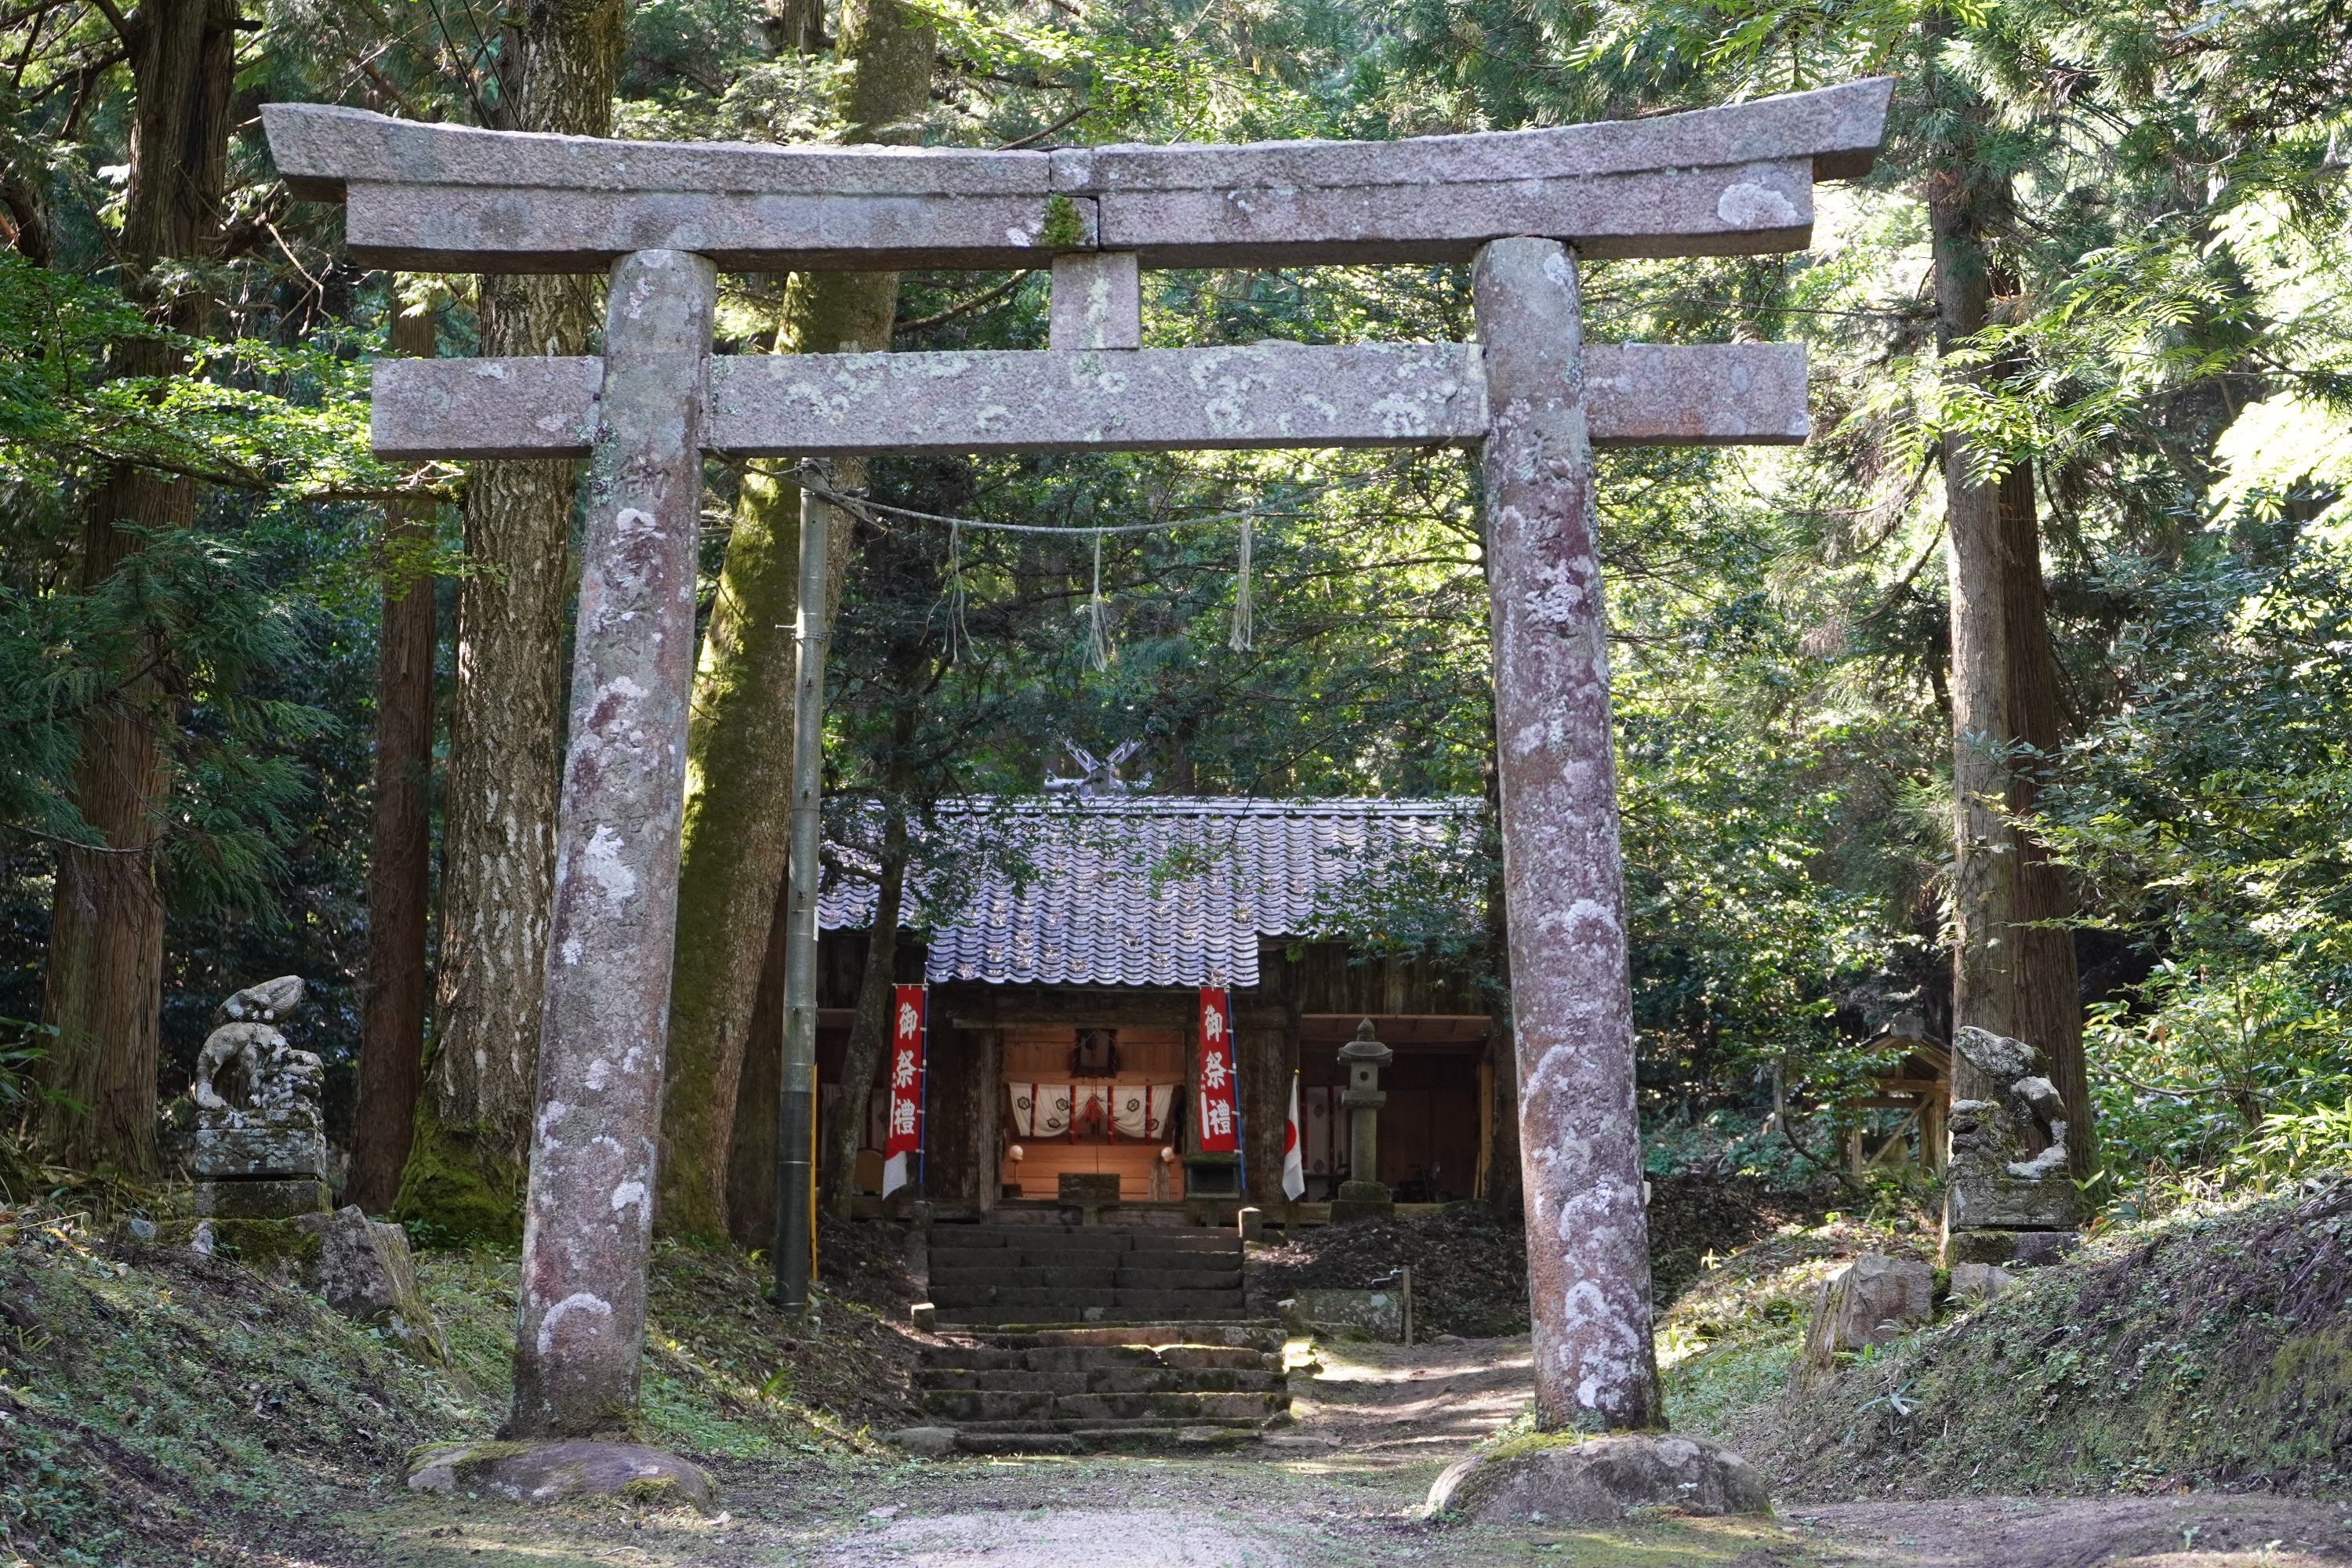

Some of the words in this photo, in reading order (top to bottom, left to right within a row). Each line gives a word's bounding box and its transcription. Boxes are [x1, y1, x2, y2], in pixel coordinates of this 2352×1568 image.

[895, 1001, 918, 1135] 御祭禮
[1204, 1004, 1232, 1135] 御祭禮
